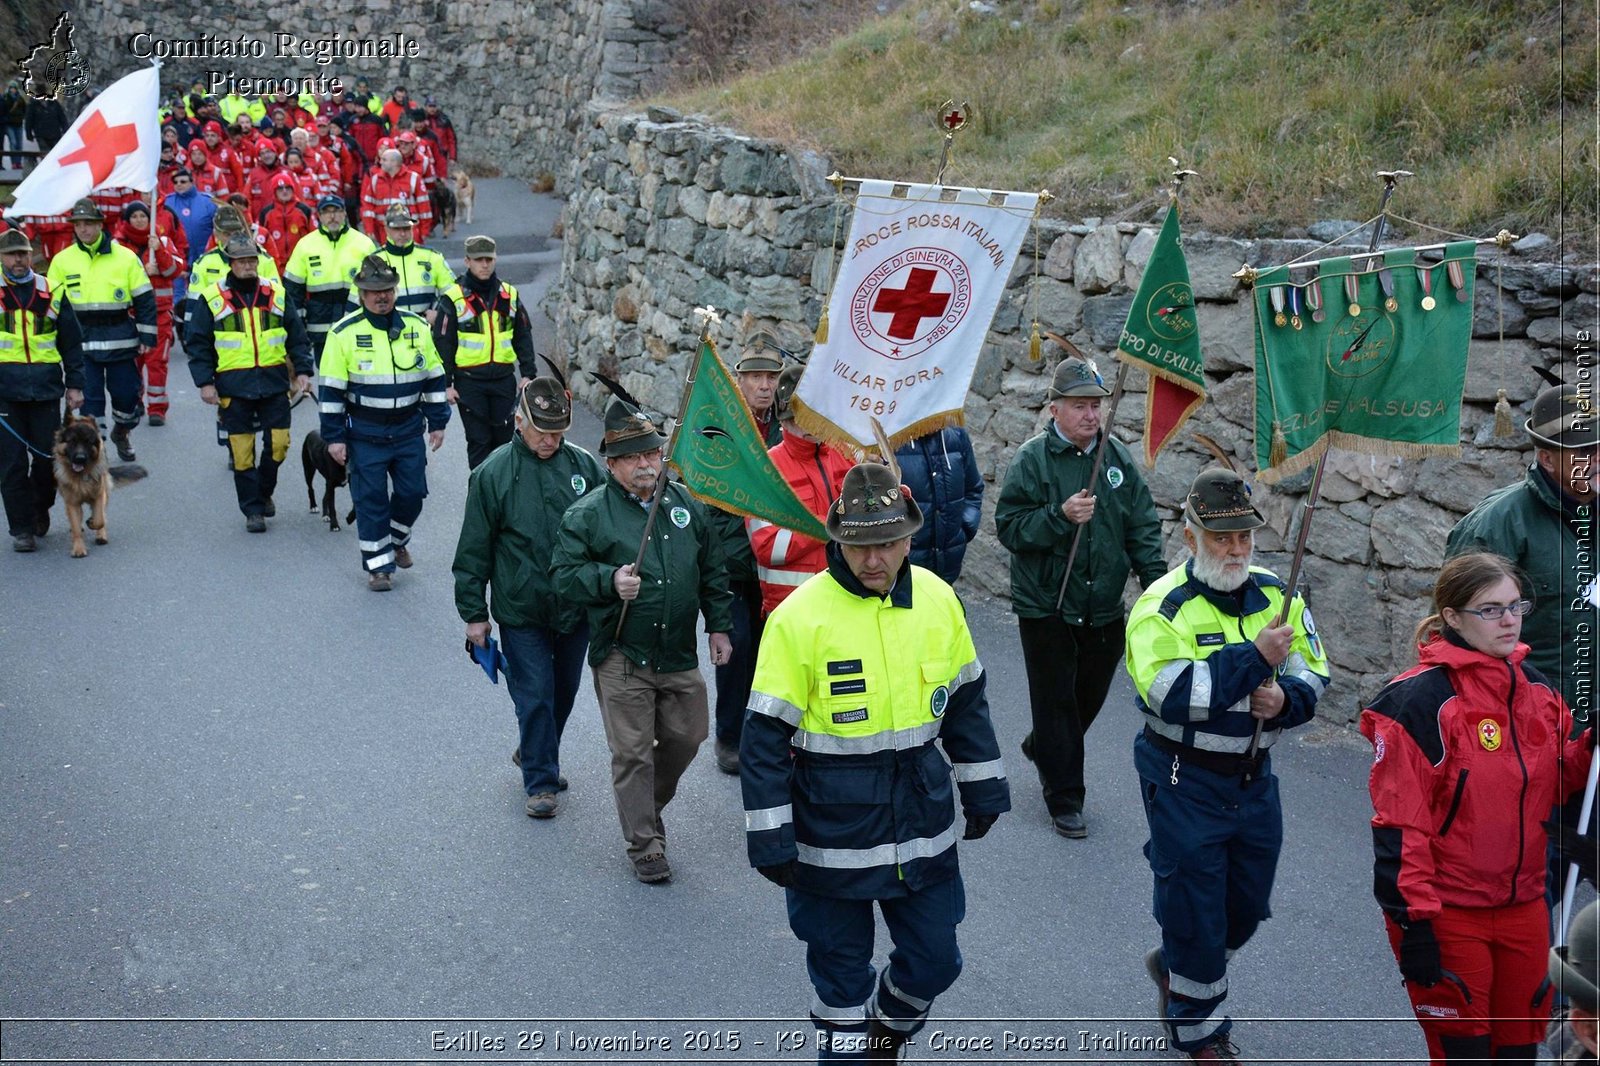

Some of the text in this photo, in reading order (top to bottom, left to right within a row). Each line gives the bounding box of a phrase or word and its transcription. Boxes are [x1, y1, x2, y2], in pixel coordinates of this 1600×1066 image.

[907, 214, 960, 230] ROSSA
[854, 251, 969, 344] CONVENZIONE DI GINEVRA 22 AGOSTO 1864
[1120, 330, 1146, 351] PPO
[1147, 343, 1162, 359] DI
[833, 359, 944, 392] VILLAR DORA
[850, 395, 896, 415] 1989
[1281, 396, 1447, 435] EZIOE VALSUSA
[733, 489, 750, 505] DI
